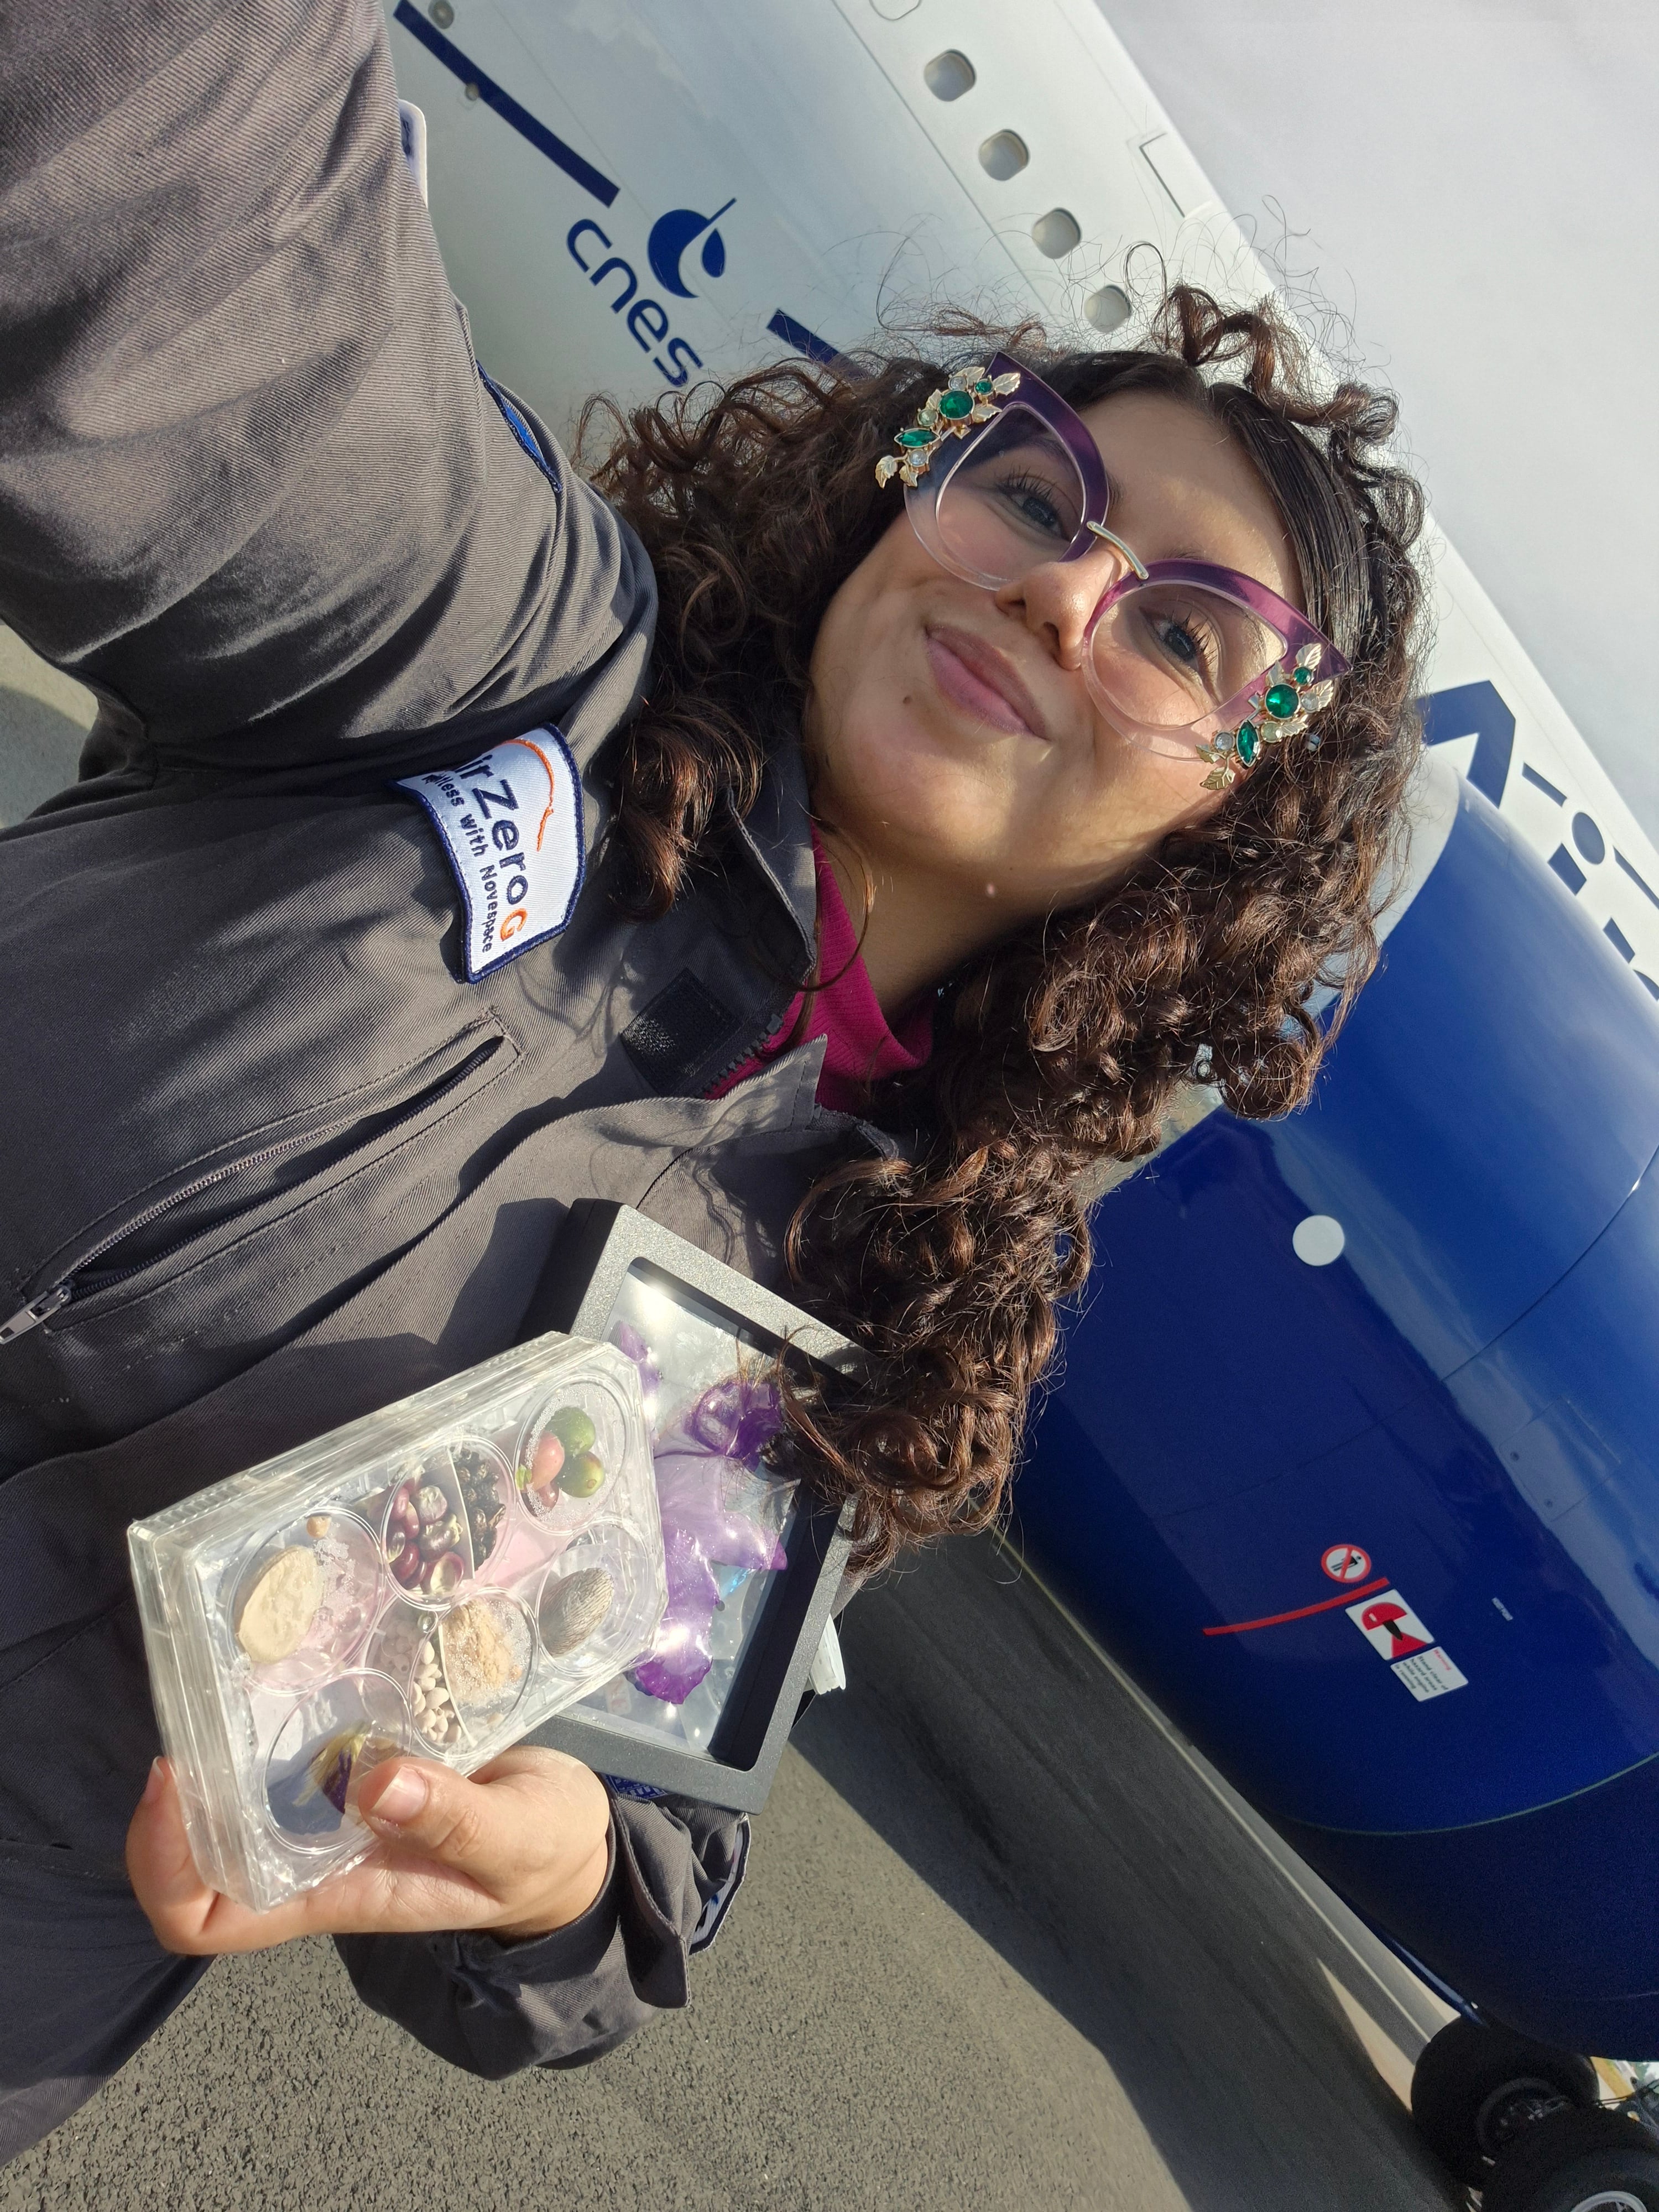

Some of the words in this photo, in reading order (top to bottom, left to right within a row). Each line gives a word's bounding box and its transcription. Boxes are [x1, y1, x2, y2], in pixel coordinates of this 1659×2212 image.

[566, 219, 703, 387] cnes
[460, 814, 489, 857] with
[479, 865, 498, 953] Novespace
